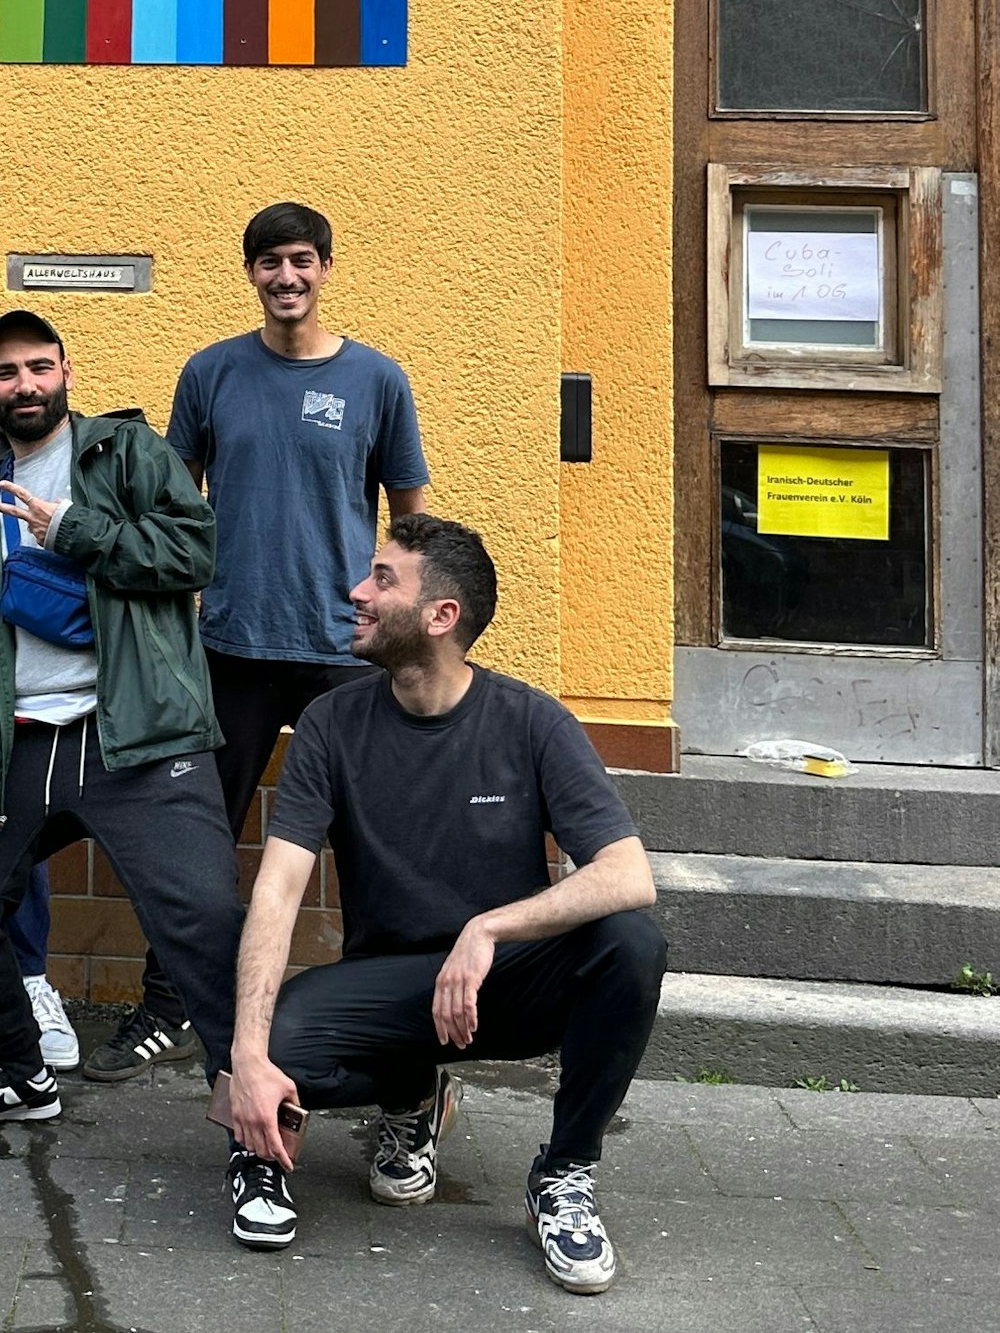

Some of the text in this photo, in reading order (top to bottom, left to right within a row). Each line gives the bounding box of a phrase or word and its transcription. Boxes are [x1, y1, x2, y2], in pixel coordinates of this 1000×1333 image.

[27, 268, 116, 279] ALLERWELTSHAUS
[816, 283, 848, 299] OG
[766, 475, 854, 487] Iranisch-Deutscher
[766, 491, 828, 503] Frauenverein
[850, 494, 873, 505] Köln
